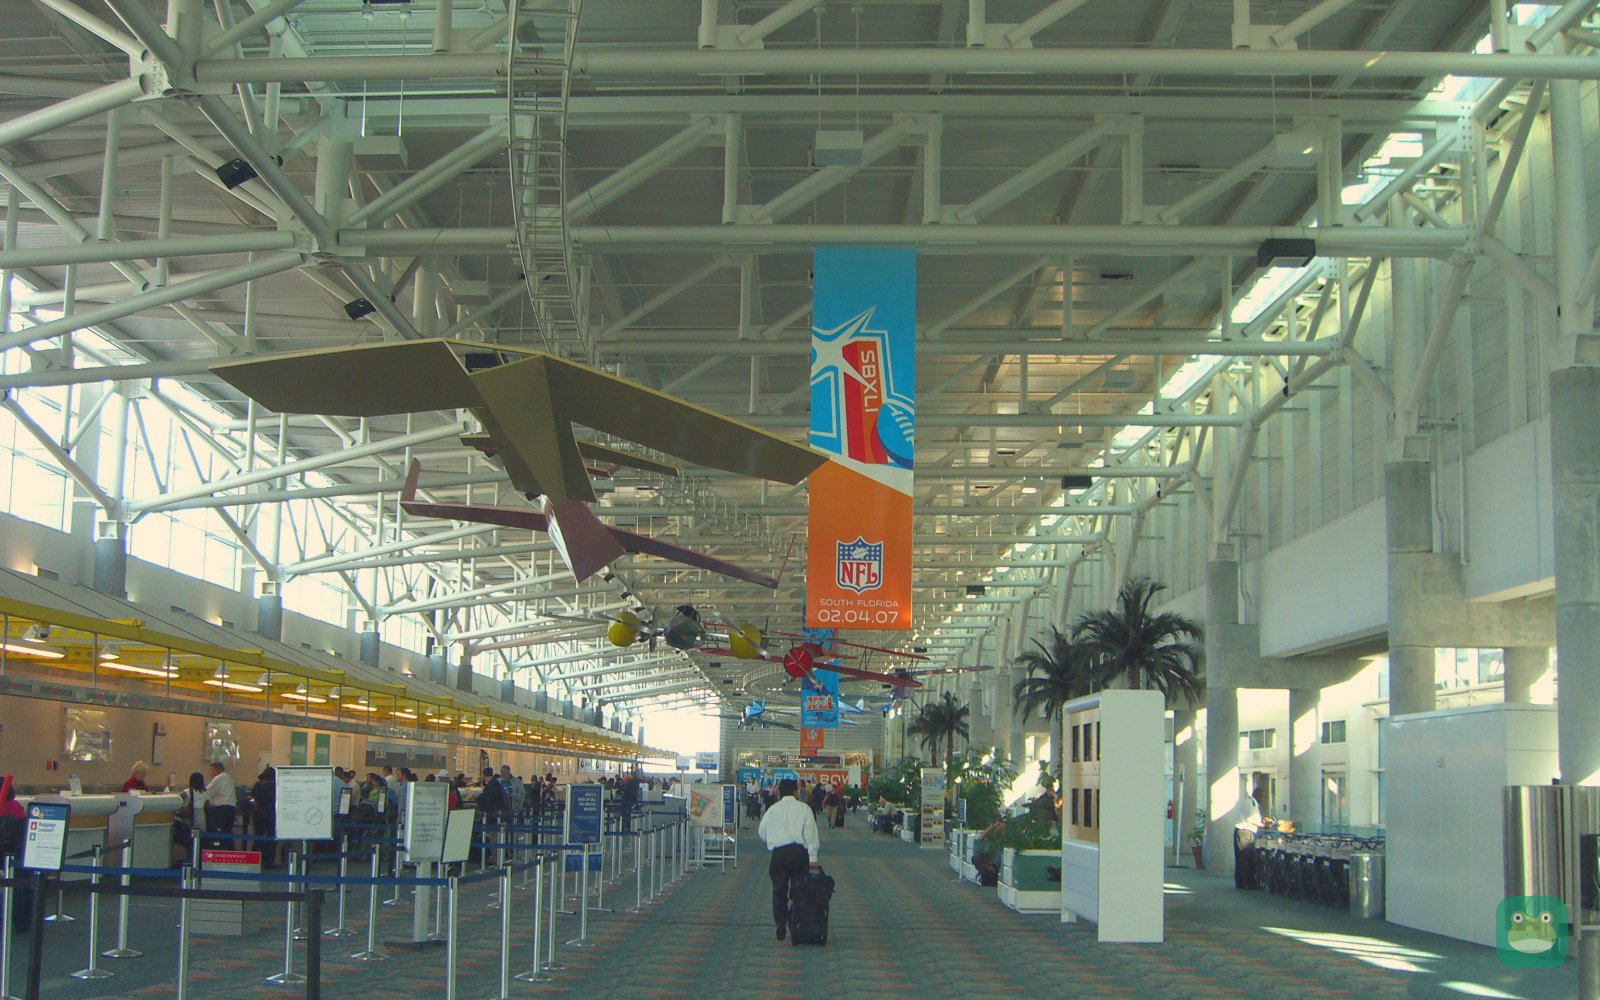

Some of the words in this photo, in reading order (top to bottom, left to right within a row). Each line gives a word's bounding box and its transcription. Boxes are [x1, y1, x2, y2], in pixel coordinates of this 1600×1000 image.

[861, 350, 879, 412] SBXLI
[840, 561, 878, 587] NFL
[819, 598, 853, 607] SOUTH
[857, 599, 899, 608] FLORIDA
[818, 609, 899, 624] 02.04.07
[820, 774, 849, 785] BOW
